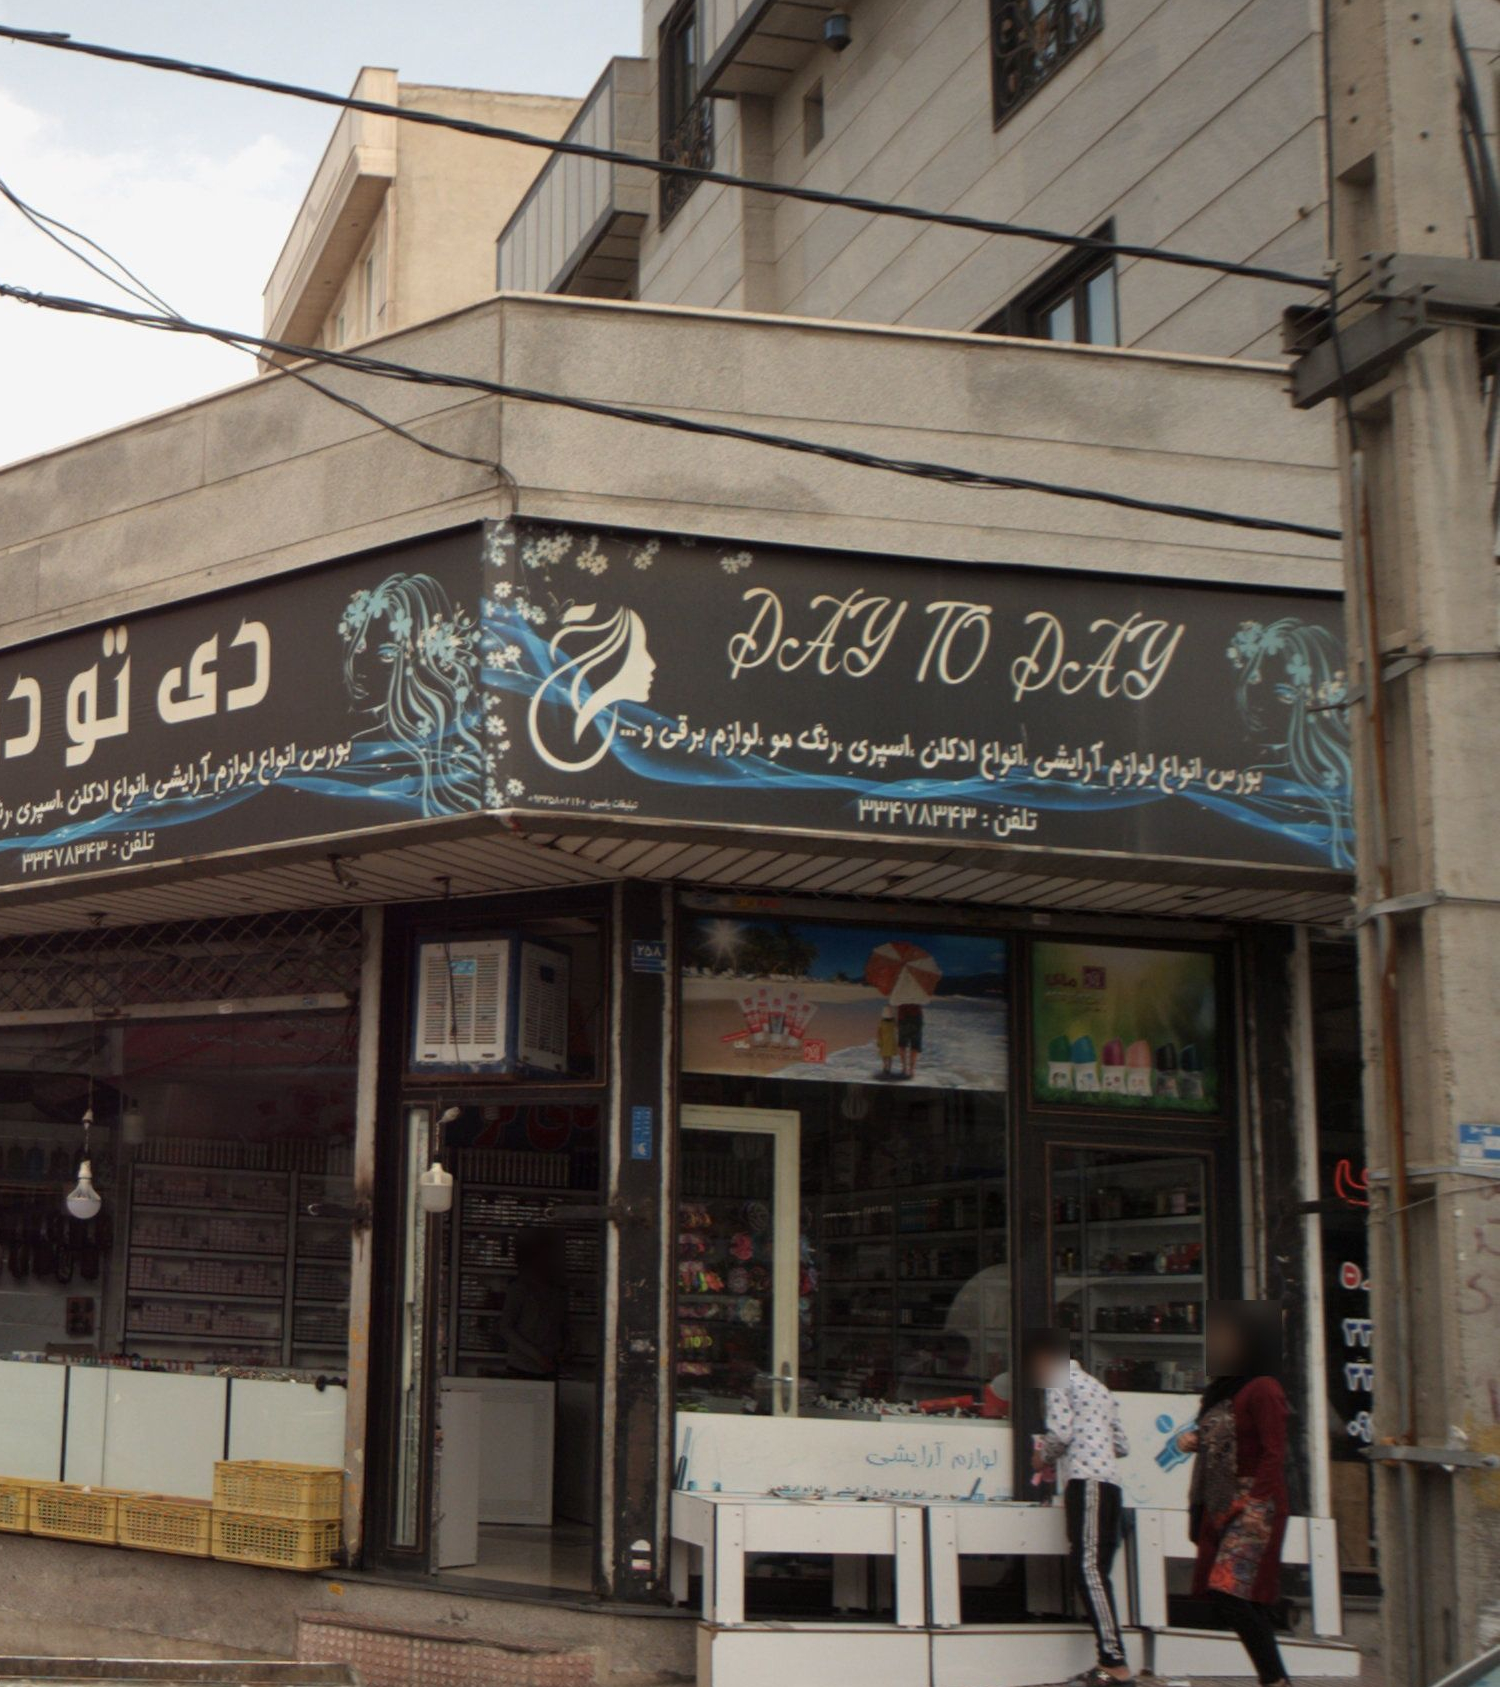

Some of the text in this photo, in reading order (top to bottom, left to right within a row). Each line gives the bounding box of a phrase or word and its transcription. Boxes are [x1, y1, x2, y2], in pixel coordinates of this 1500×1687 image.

[727, 587, 1184, 704] DAY TO DAY
[157, 617, 271, 725] دی
[65, 623, 132, 769] تو
[658, 714, 706, 755] برقی
[769, 733, 793, 758] مو
[918, 737, 976, 769] ادکلن
[214, 751, 254, 795] لوازم
[257, 742, 296, 786] انواع
[299, 740, 352, 772] بورس
[1033, 741, 1104, 784] آرایشی
[1108, 751, 1155, 790] لوازم
[153, 751, 212, 800] آرایشی
[1159, 756, 1202, 795] انواع
[1206, 768, 1263, 794] بورس
[67, 779, 109, 816] ادکلن
[858, 798, 977, 830] ۳۳۴۷۸۳۴۳
[993, 805, 1039, 837] تلفن
[21, 839, 109, 873] ۳۳۴۷۸۳۴۳
[120, 831, 156, 861] تلفن
[636, 944, 662, 957] ۲۵۸
[865, 1441, 998, 1470] لوازم آرایشی
